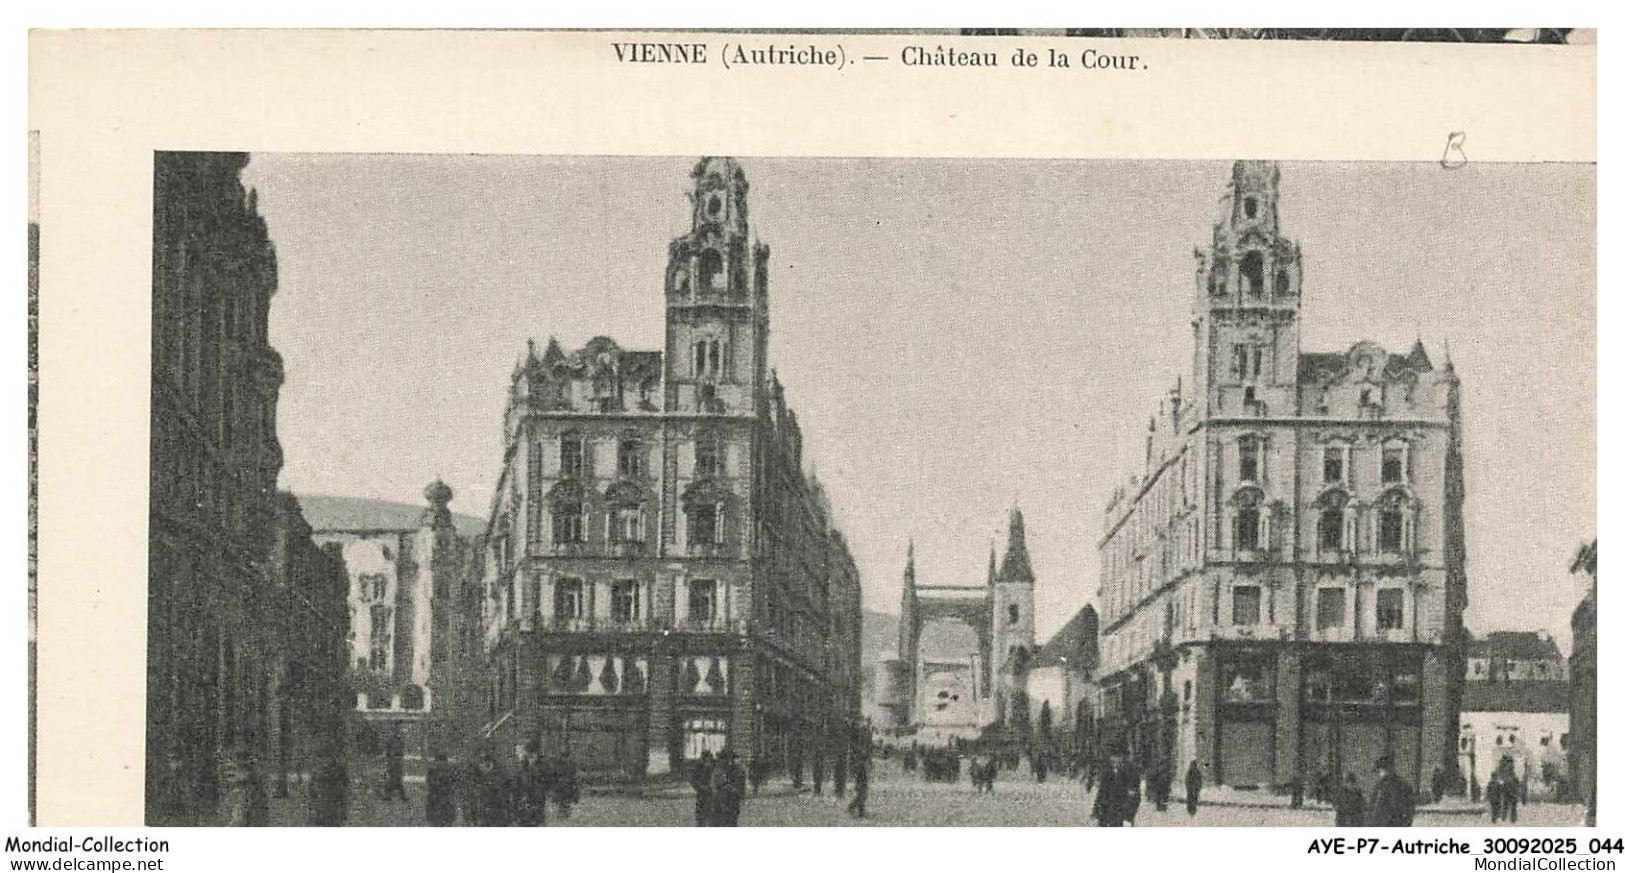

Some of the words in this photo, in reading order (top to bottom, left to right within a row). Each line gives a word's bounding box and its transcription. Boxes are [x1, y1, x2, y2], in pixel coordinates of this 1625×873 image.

[612, 43, 707, 65] VIENNE
[721, 44, 855, 70] (Autriche).
[901, 45, 998, 68] Château
[1011, 48, 1038, 68] de
[1048, 48, 1071, 69] la
[1081, 49, 1149, 71] Cour.
